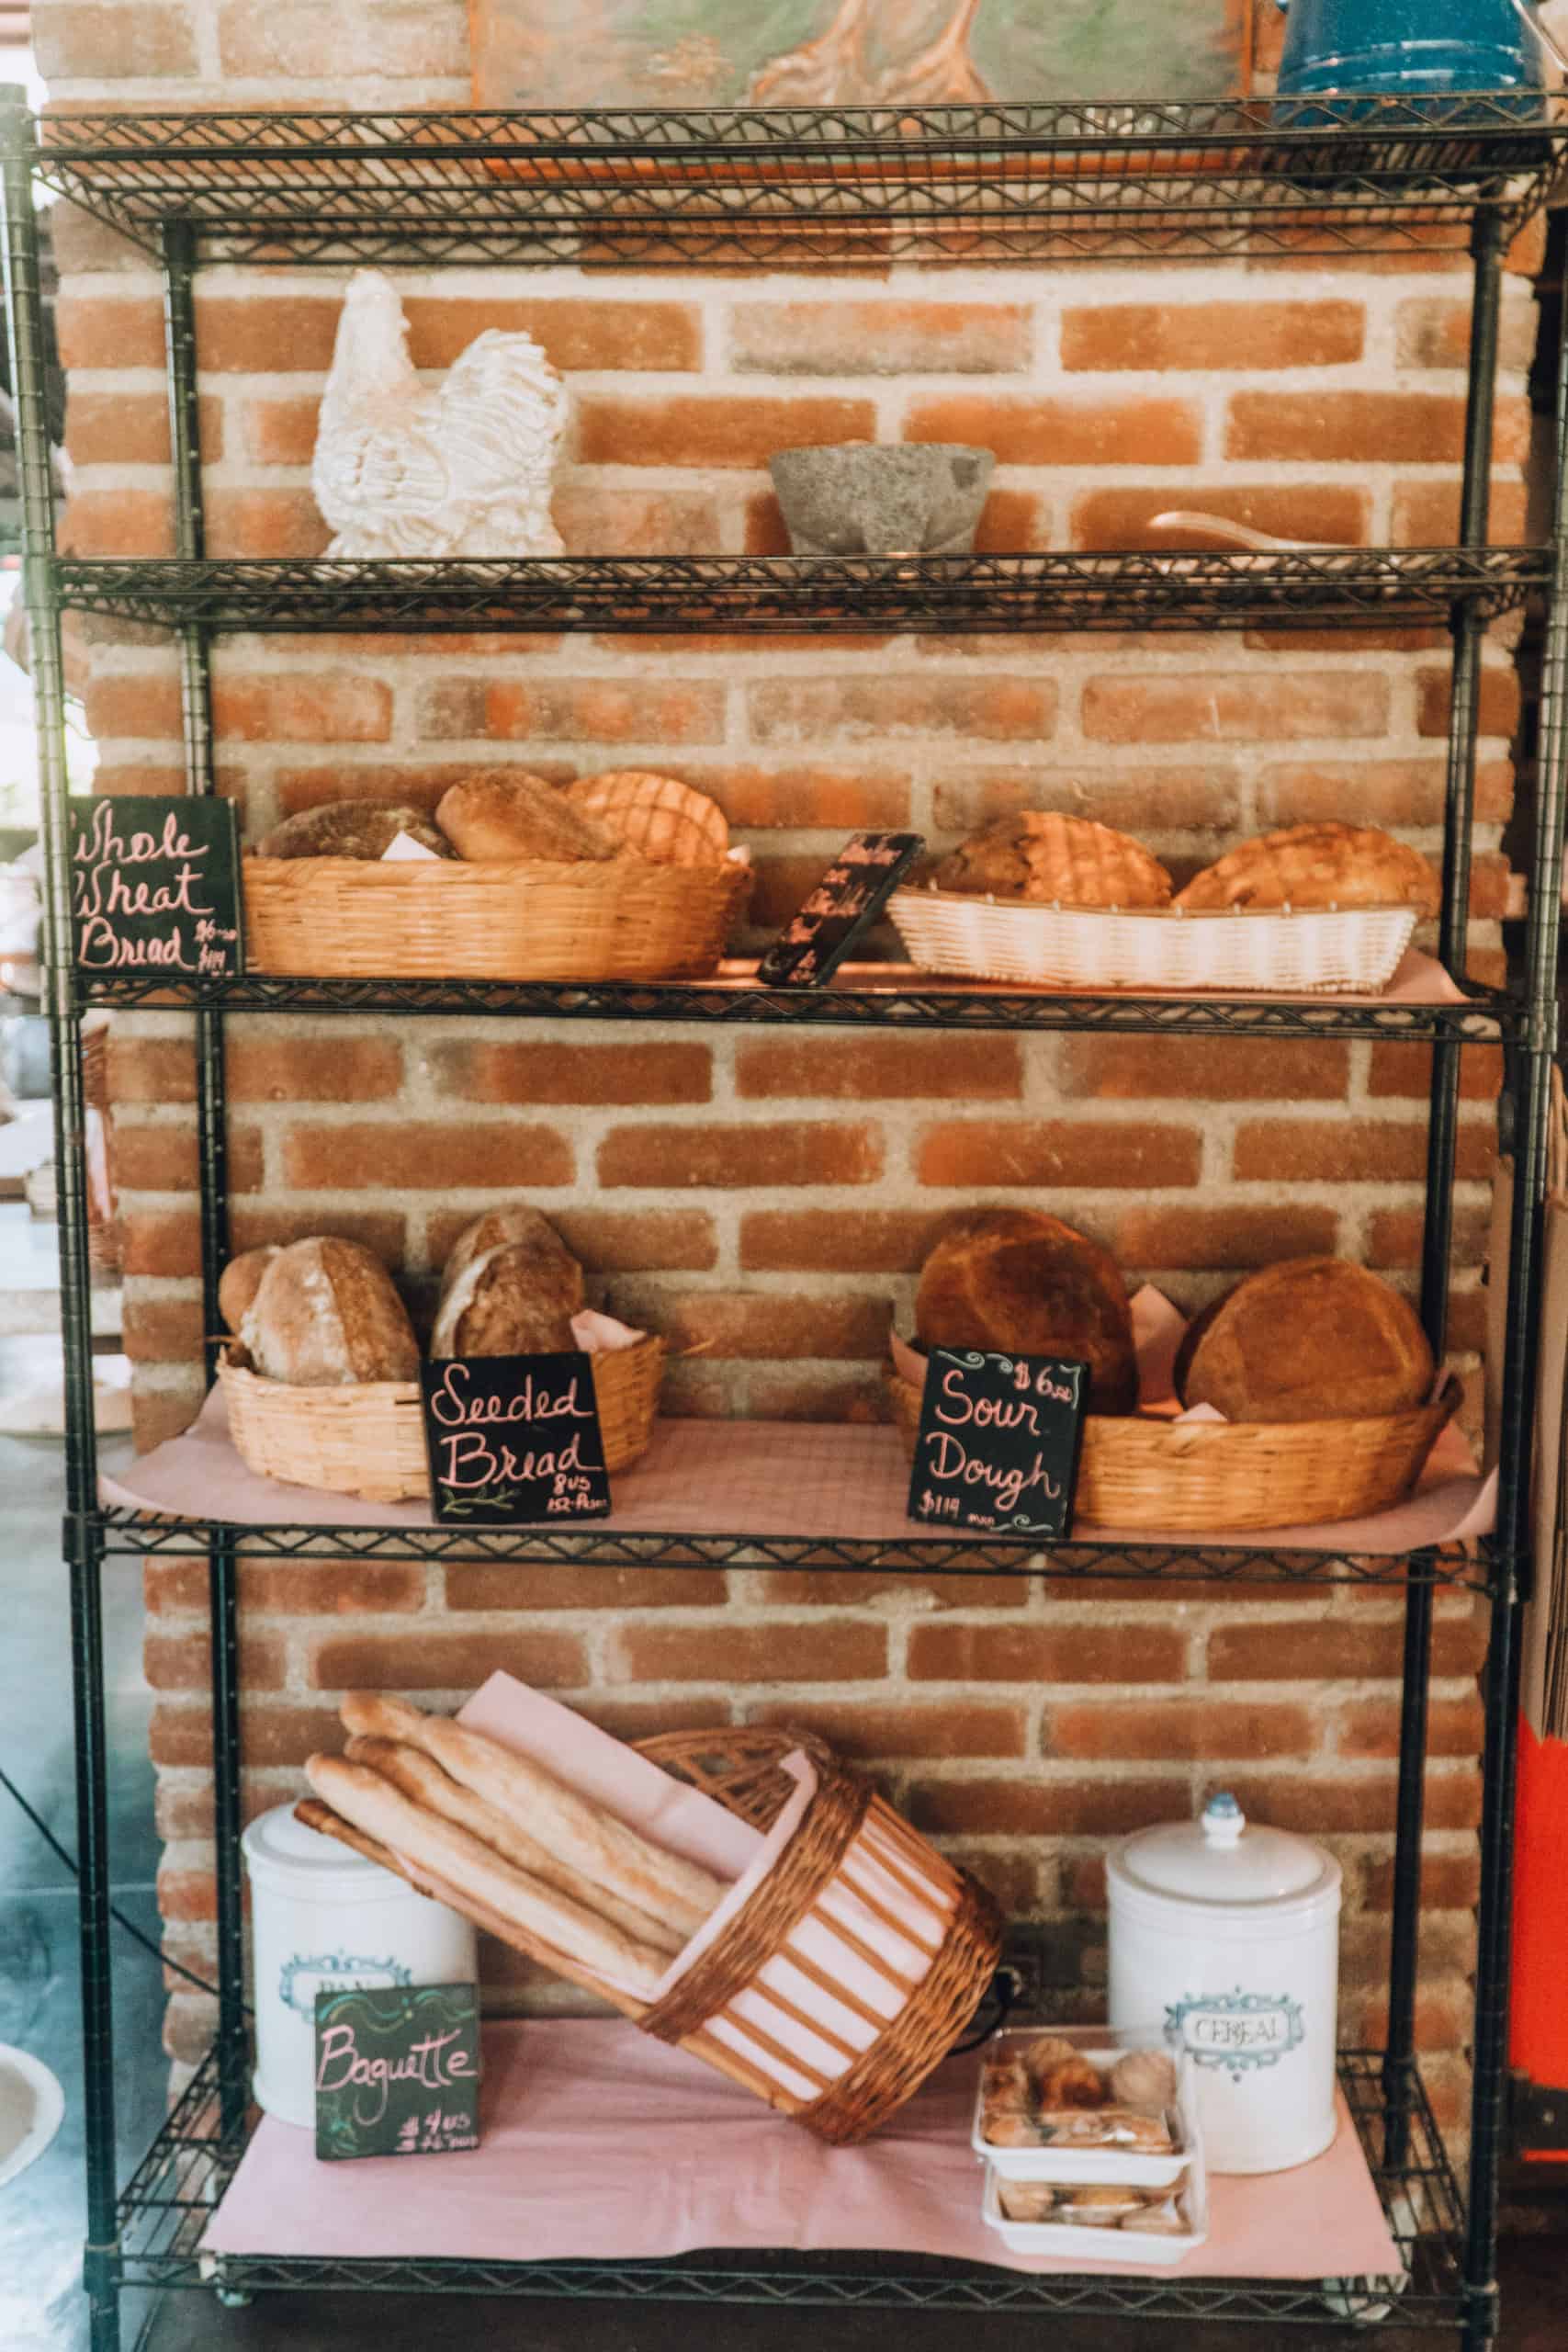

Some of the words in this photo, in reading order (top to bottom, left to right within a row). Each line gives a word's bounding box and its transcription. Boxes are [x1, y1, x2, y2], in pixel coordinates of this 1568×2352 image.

[71, 799, 209, 864] Whole
[74, 860, 216, 919] Wheat
[78, 917, 197, 969] Bread
[431, 1363, 595, 1426] Seeded
[934, 1369, 1041, 1437] Sour
[438, 1431, 604, 1488] Bread
[925, 1431, 1060, 1511] Dough
[1195, 2017, 1282, 2044] CEREAL
